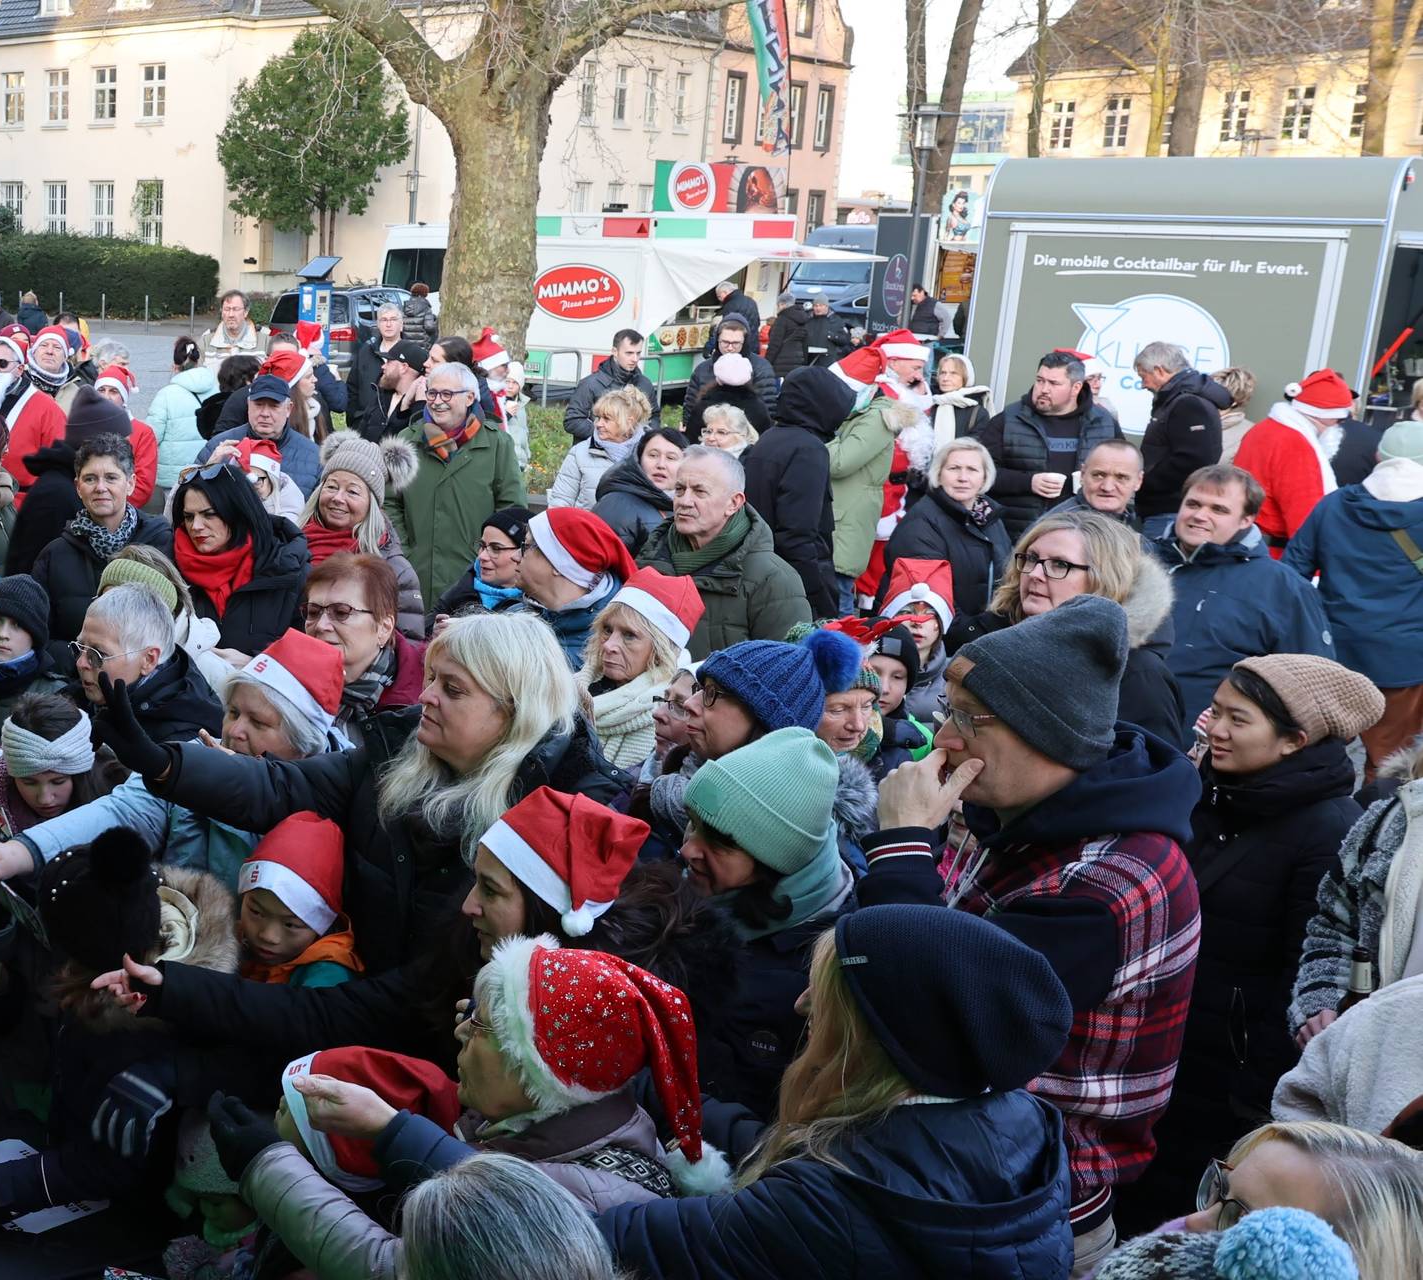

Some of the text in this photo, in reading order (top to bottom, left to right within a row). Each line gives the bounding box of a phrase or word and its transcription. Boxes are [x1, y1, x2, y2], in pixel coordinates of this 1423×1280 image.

[1033, 254, 1310, 276] Die mobile Cocktailbar für Ihr Event.
[538, 276, 611, 299] MIMMO'S
